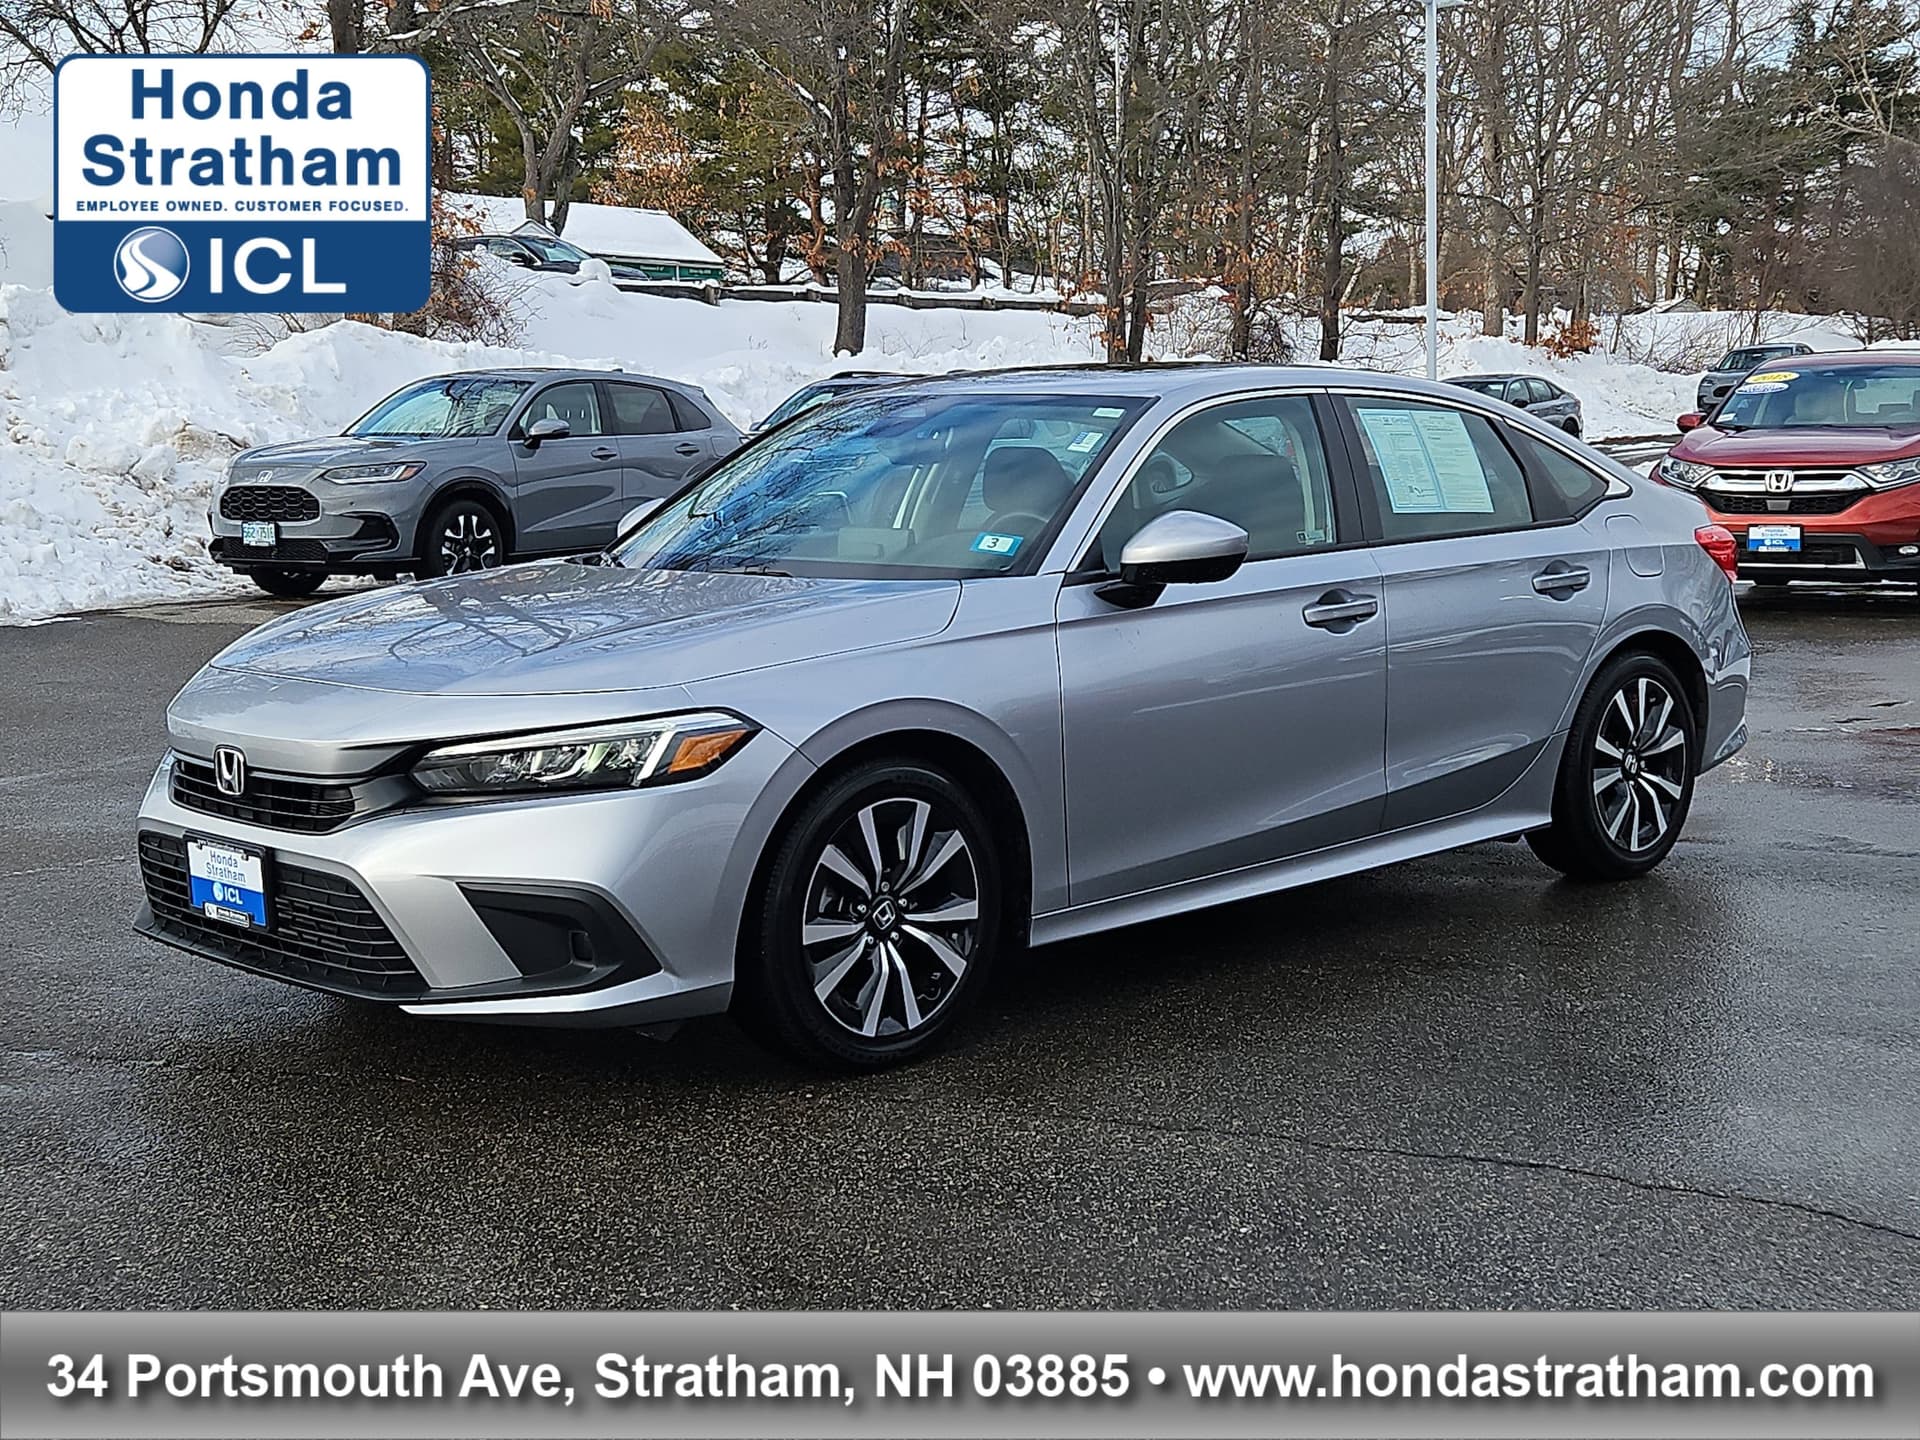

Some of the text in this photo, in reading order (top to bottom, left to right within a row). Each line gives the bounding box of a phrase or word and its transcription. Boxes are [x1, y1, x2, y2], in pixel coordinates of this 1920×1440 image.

[986, 537, 1000, 549] 3
[210, 850, 238, 867] Honda
[206, 862, 246, 882] Stratham
[224, 886, 243, 904] ICL
